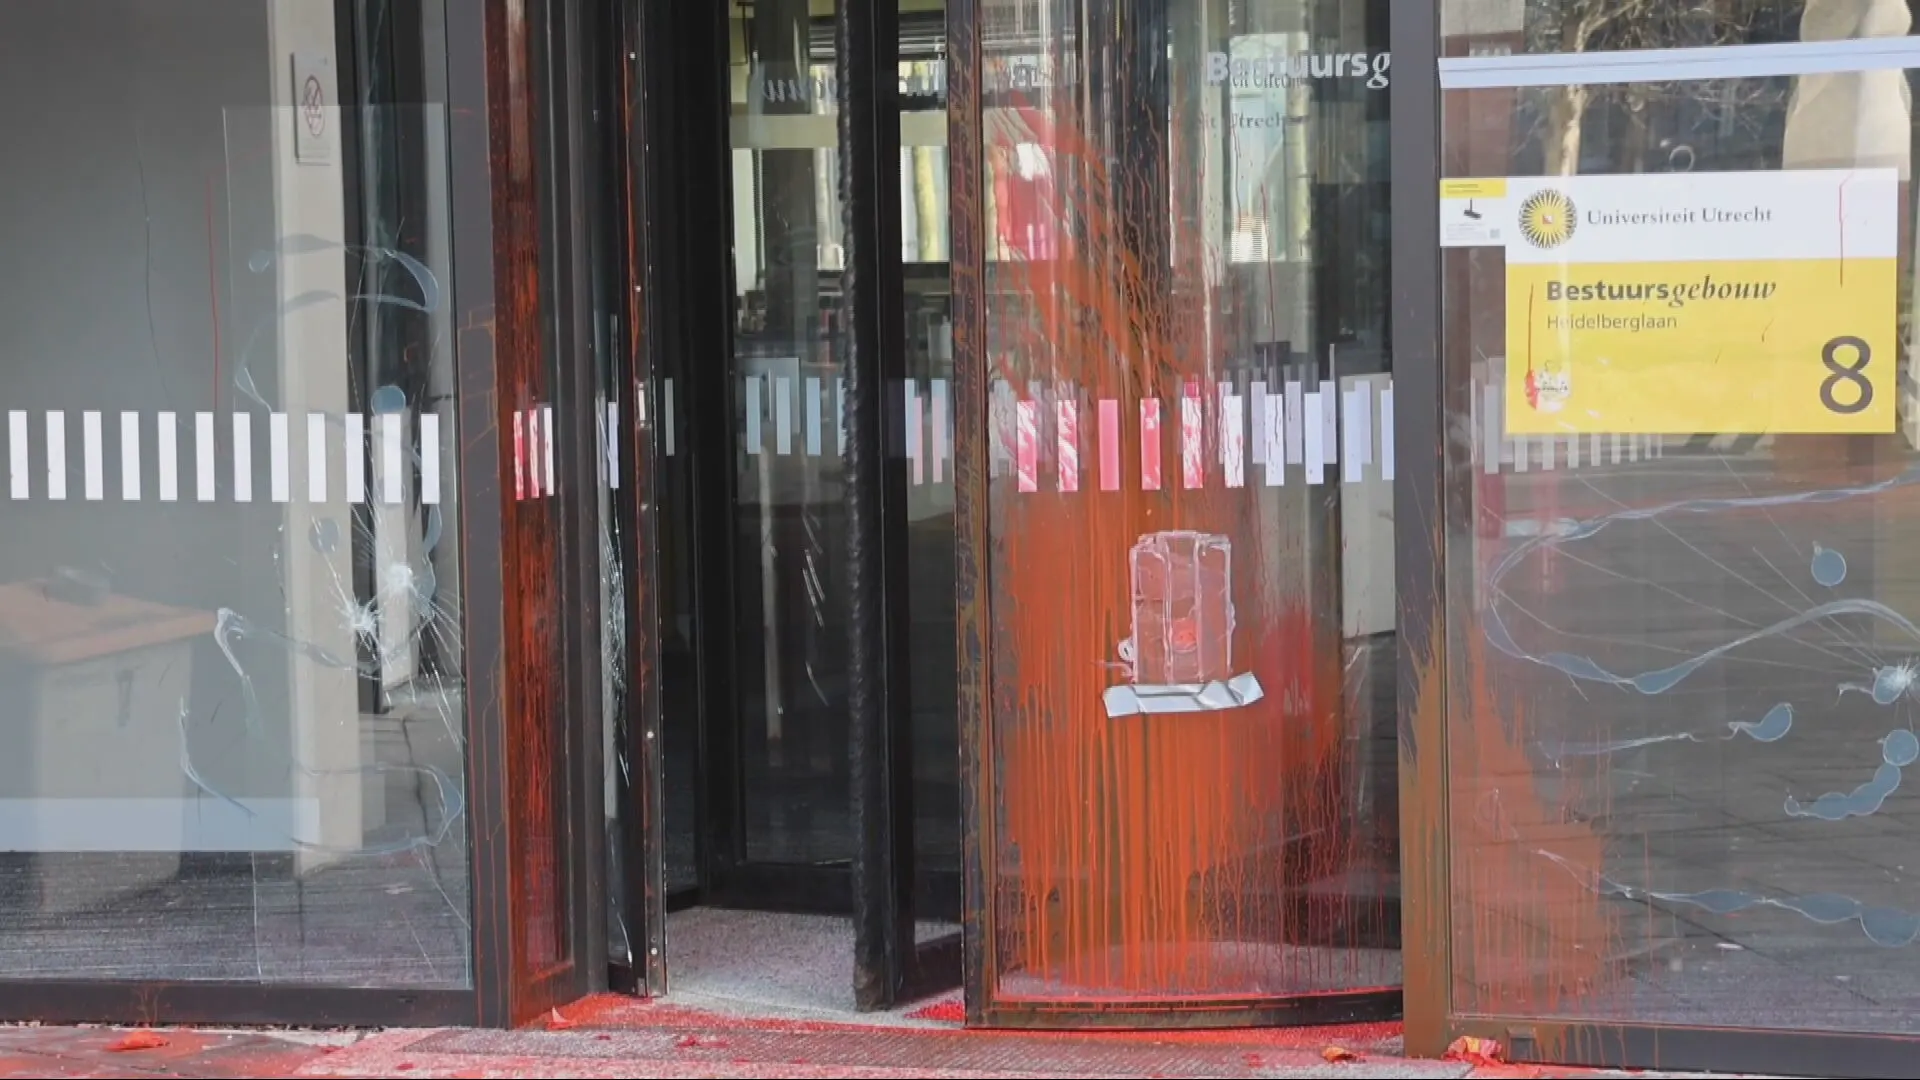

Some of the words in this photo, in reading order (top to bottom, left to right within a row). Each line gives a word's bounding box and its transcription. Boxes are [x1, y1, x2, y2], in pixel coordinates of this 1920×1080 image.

[1586, 207, 1696, 226] Universiteit
[1701, 205, 1773, 224] Utrecht
[1546, 273, 1777, 308] Bestuursgebouw
[1546, 312, 1678, 333] Heidelberglaan
[1819, 334, 1875, 415] 8
